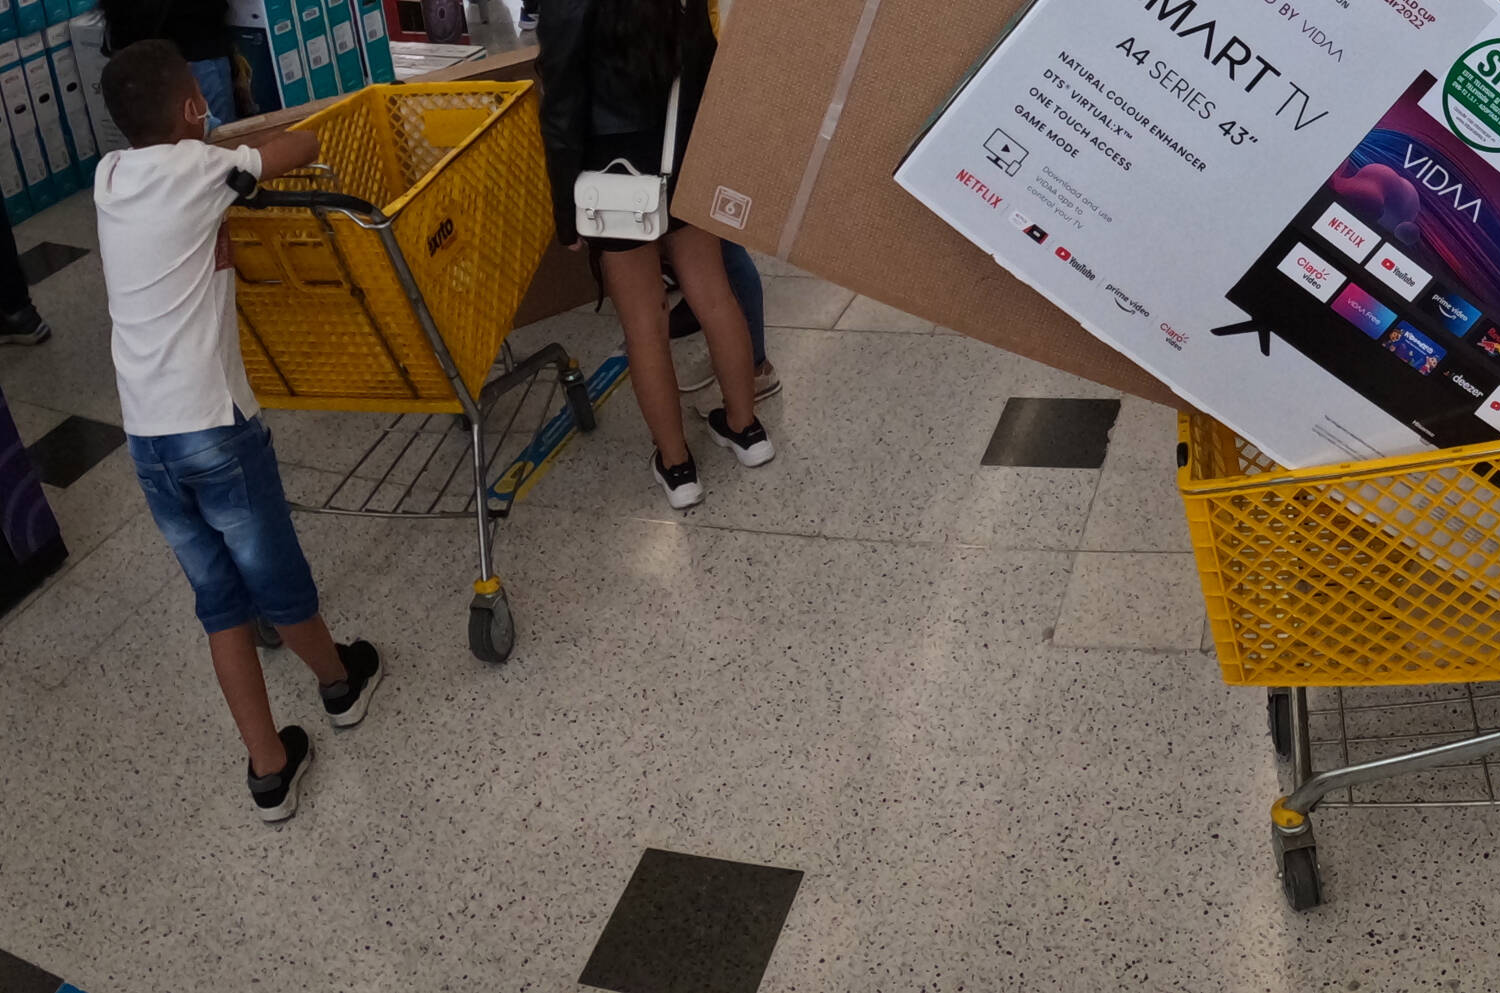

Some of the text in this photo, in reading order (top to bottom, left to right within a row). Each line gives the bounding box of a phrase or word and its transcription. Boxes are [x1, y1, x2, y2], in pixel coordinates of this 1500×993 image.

[1417, 5, 1436, 24] CUP
[1278, 2, 1300, 22] BY
[1300, 19, 1345, 63] VIDAA
[1115, 36, 1151, 67] A4
[1149, 60, 1217, 121] SERIES
[1057, 49, 1207, 173] NATURAL COLOUR ENHANCER
[1275, 80, 1329, 132] TV
[1013, 104, 1080, 160] GAME MODE
[1028, 86, 1133, 172] ONE TOUCH ACCESS
[955, 168, 1003, 209] NETFLIX
[1035, 175, 1084, 216] VIDAA app to
[1041, 165, 1113, 223] Download and use
[1403, 142, 1483, 224] VIDAA
[1026, 184, 1056, 209] control
[1072, 219, 1085, 230] TV
[1327, 216, 1366, 249] NETFLIX
[1068, 256, 1096, 281] YouTube
[1296, 256, 1323, 280] Claro
[1302, 272, 1322, 290] video
[1392, 265, 1416, 288] YouTube
[1105, 283, 1150, 318] prime video
[1432, 293, 1468, 322] prime video
[1160, 322, 1184, 343] Claro
[1364, 311, 1381, 326] Free
[1165, 336, 1183, 352] video
[1452, 373, 1484, 399] deezer
